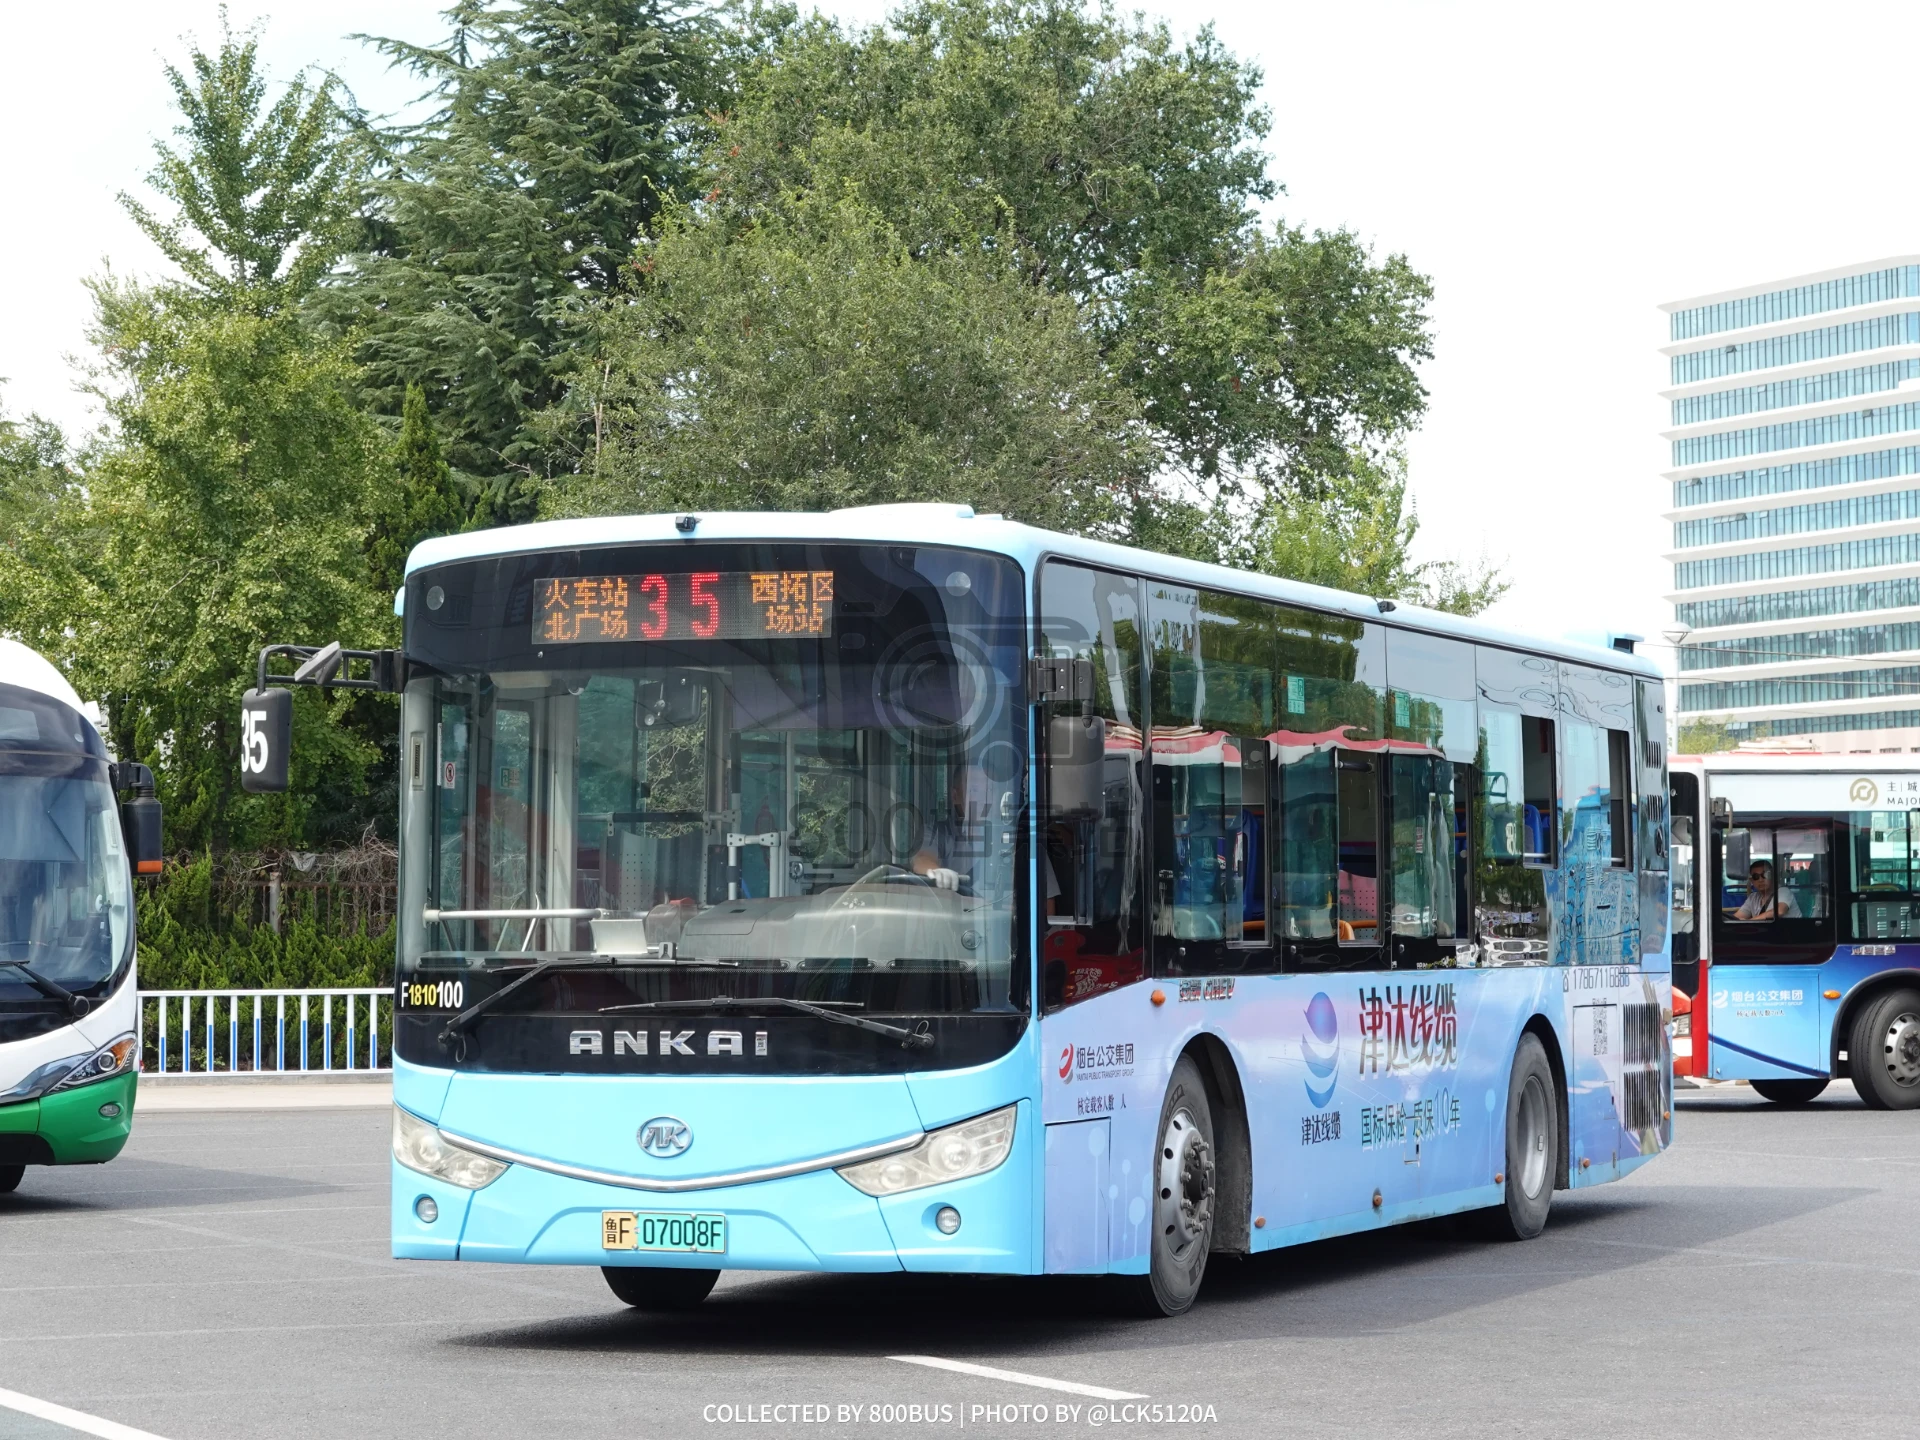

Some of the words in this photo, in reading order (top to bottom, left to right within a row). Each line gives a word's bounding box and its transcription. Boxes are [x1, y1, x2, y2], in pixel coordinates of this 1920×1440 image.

[544, 577, 629, 609] 火车站
[751, 573, 834, 603] 西拓区
[544, 609, 629, 640] 北广场
[766, 603, 823, 634] 场站
[1887, 797, 1920, 806] MAJO
[1573, 966, 1630, 989] 17867116888
[401, 981, 463, 1008] F1810100
[1731, 989, 1803, 1002] 烟台公交集团
[569, 1030, 768, 1056] ANKAI
[1358, 983, 1458, 1078] 津达线缆
[1076, 1043, 1134, 1069] 烟台公交集团
[1301, 1111, 1341, 1146] 津达线缆
[643, 1218, 723, 1247] 07008F
